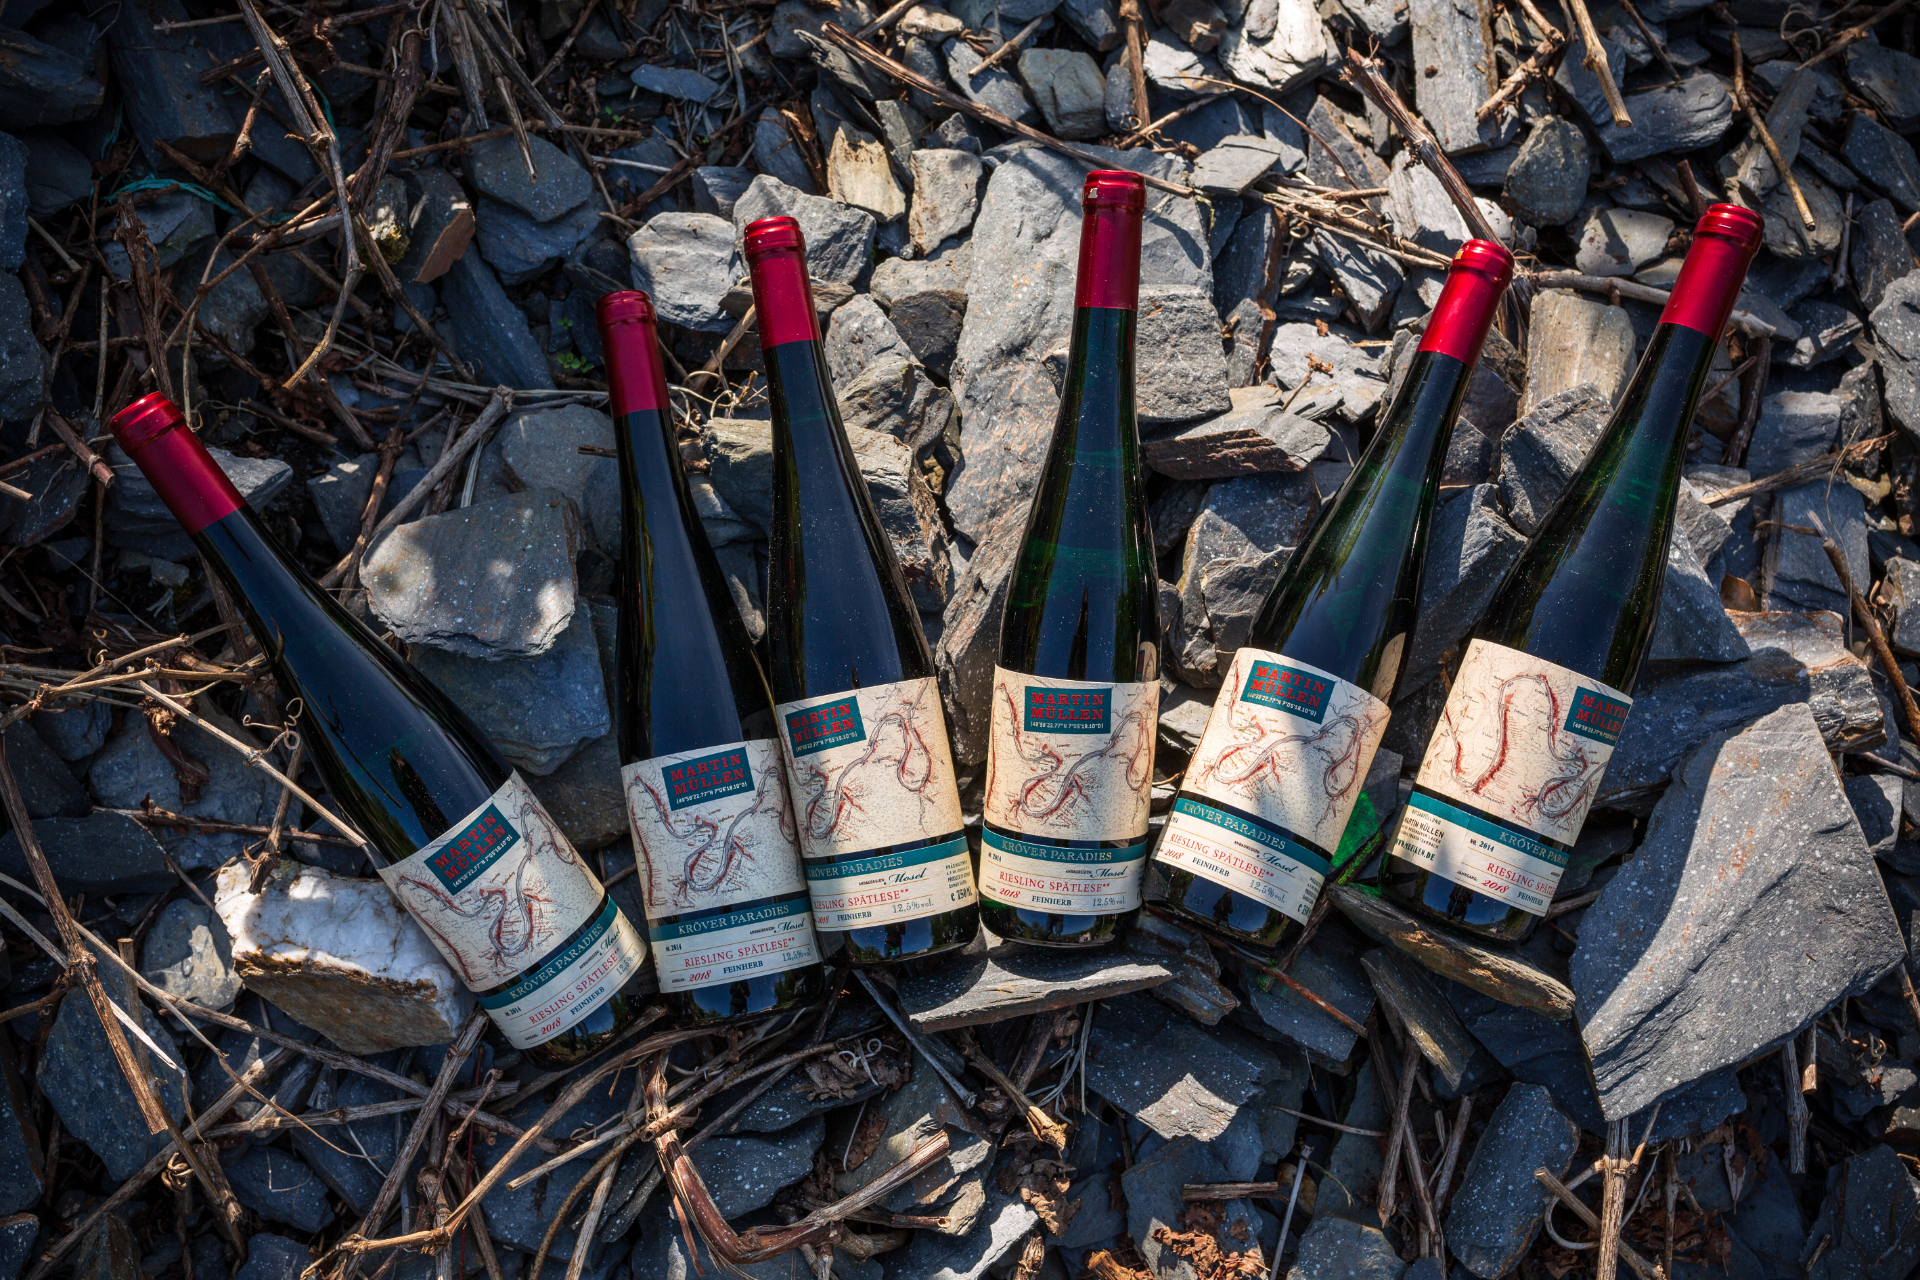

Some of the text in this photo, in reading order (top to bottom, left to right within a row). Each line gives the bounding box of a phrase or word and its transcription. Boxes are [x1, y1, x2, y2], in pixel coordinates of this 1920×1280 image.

[1255, 666, 1326, 694] MARTIN
[1031, 692, 1104, 705] MARTIN
[1250, 679, 1321, 707] MÜLLEN
[790, 703, 851, 729] MARTIN
[1031, 706, 1104, 720] MÜLLEN
[793, 717, 854, 743] MÜLLEN
[670, 754, 741, 781] MARTIN
[673, 768, 744, 795] MÜLLEN
[1182, 802, 1286, 850] KRÖVER PARADIES
[434, 813, 496, 869] MARTIN
[443, 824, 506, 880] MÜLLEN
[1002, 840, 1111, 861] KRÖVER PARADIES
[1170, 834, 1210, 854] RIESLING
[1499, 831, 1546, 857] KRÖVER
[808, 856, 903, 877] KRÖVER PARADIES
[1090, 866, 1128, 878] Mosel
[1165, 848, 1184, 860] 2018
[1192, 857, 1230, 877] FEINHERB
[1257, 852, 1298, 873] Mosel
[884, 868, 927, 885] Mosel
[1000, 871, 1045, 888] RIESLING
[1482, 880, 1509, 893] 2018
[1487, 863, 1535, 888] RIESLING
[999, 887, 1020, 898] 2018
[1032, 895, 1072, 906] FEINHERB
[678, 905, 789, 934] KRÖVER PARADIES
[774, 918, 806, 933] Mosel
[837, 911, 872, 921] FEINHERB
[600, 924, 621, 955] Mosel
[509, 966, 556, 999] KRÖVER
[555, 924, 604, 970] PARADIES
[684, 950, 734, 967] RIESLING
[689, 969, 711, 982] 2018
[723, 960, 763, 974] FEINHERB
[528, 992, 575, 1024] RIESLING
[541, 1018, 562, 1035] 2018
[570, 986, 605, 1015] FEINHERB
